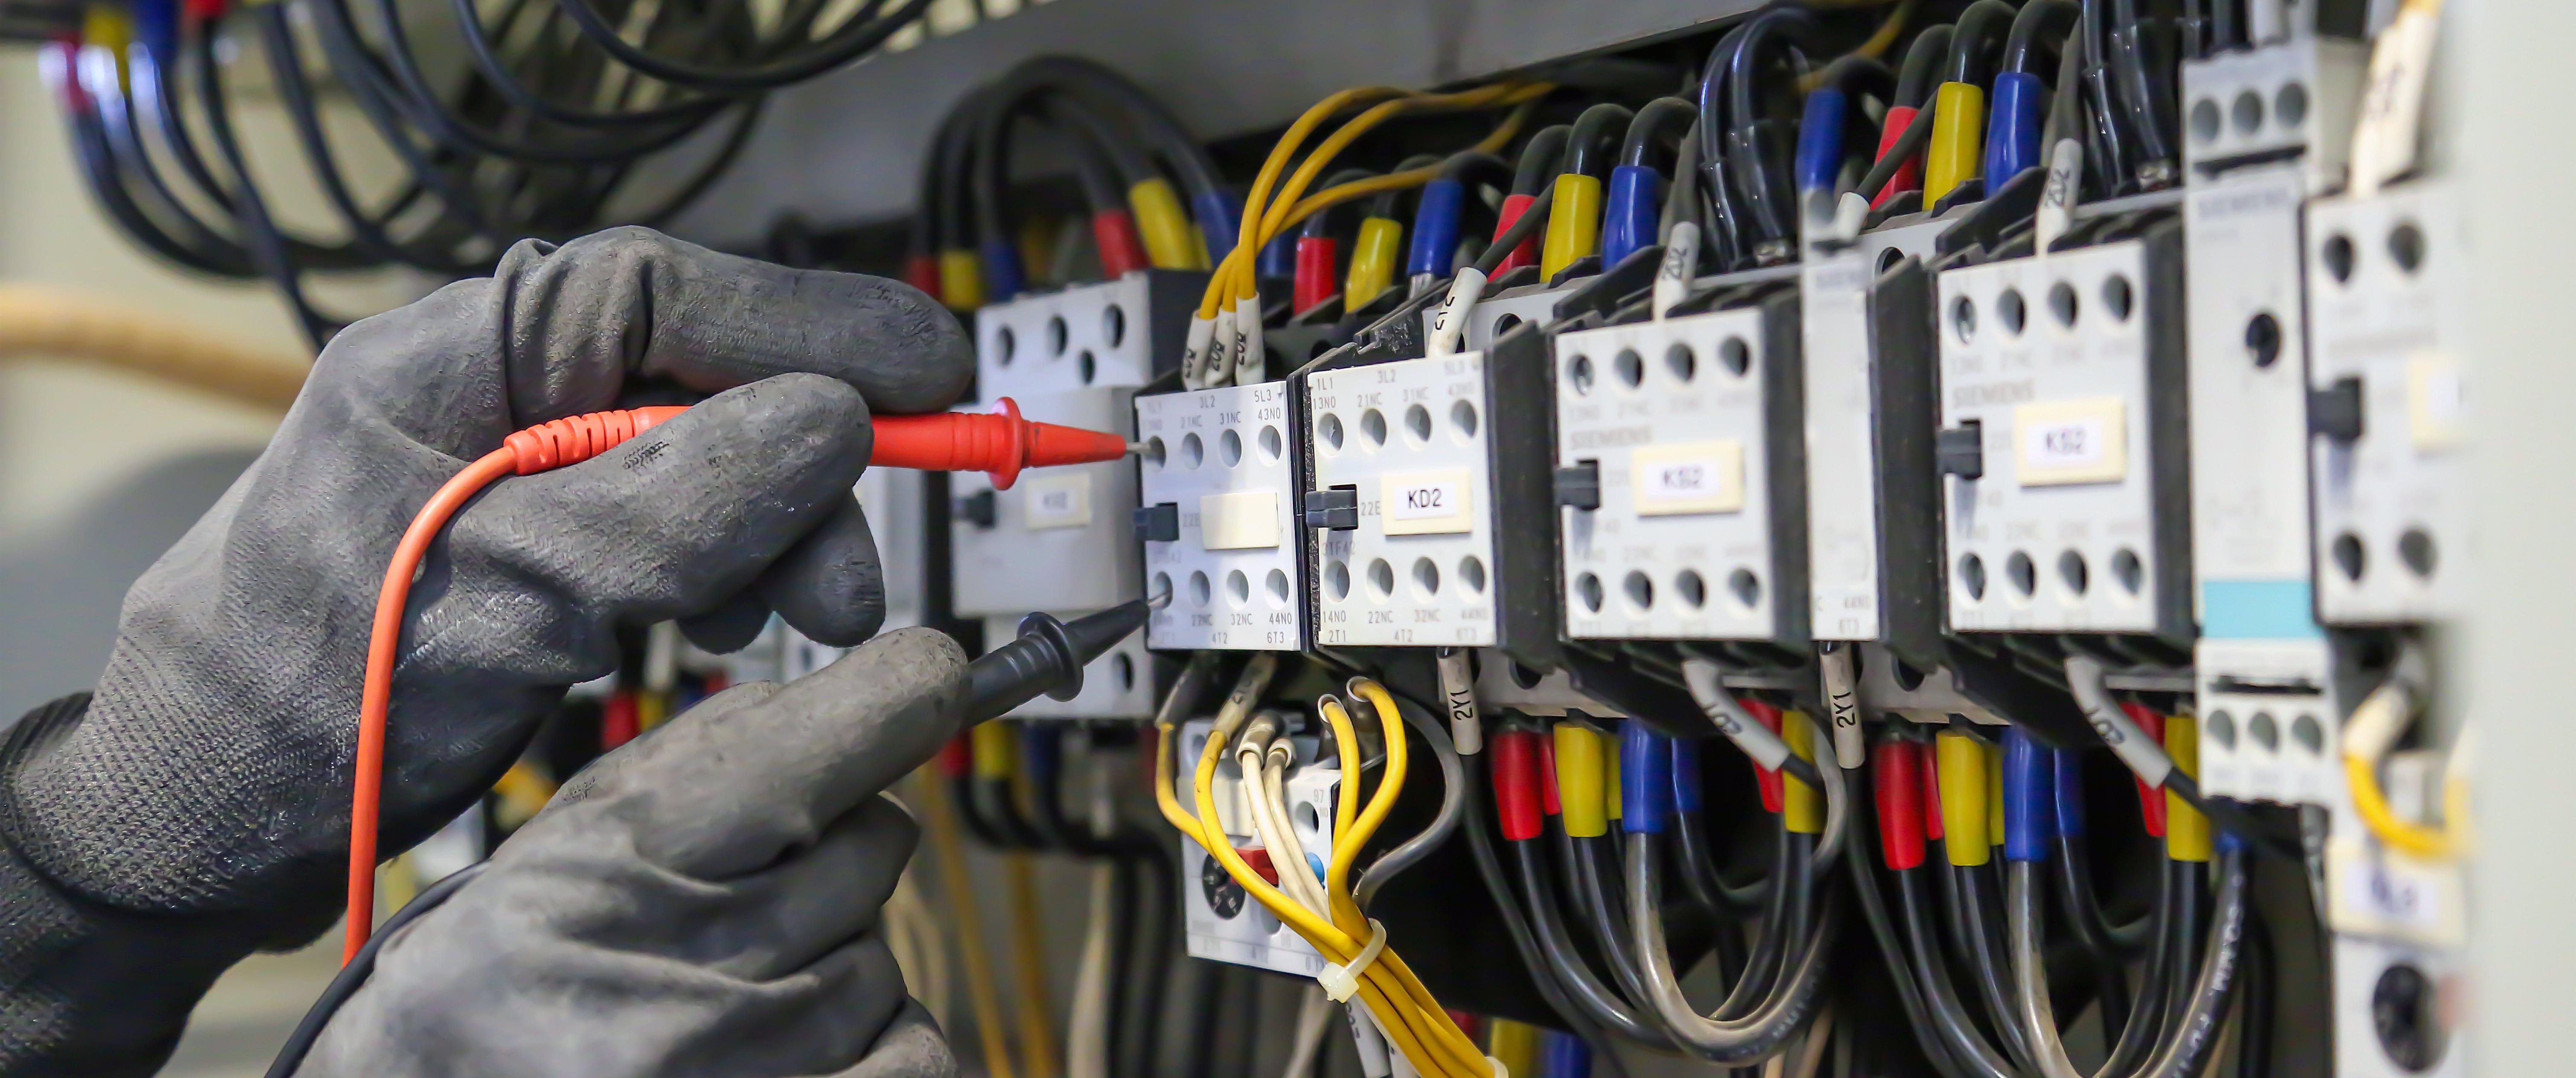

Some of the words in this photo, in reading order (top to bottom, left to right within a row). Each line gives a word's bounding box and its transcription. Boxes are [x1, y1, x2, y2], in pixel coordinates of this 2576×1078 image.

[1317, 377, 1333, 391] 1L1
[1378, 368, 1396, 383] 3L2
[1200, 395, 1215, 408] 3L2
[1254, 389, 1272, 403] 5L3
[1358, 392, 1383, 408] 21NC
[1403, 386, 1429, 403] 31NC
[1181, 415, 1203, 429] 21NC
[1219, 411, 1242, 425] 31NC
[1408, 487, 1442, 509] KD2
[1360, 500, 1381, 516] 22E
[1230, 613, 1253, 626] 32NC
[1368, 610, 1394, 624] 22NC
[1414, 609, 1442, 623] 32NC
[1212, 632, 1228, 645] 4T2
[1267, 631, 1284, 644] 6T3
[1329, 629, 1346, 643] 2T1
[1394, 629, 1413, 643] 4T2
[1450, 689, 1474, 721] 2Y1
[1832, 691, 1856, 728] 2Y1
[1313, 788, 1324, 803] 97
